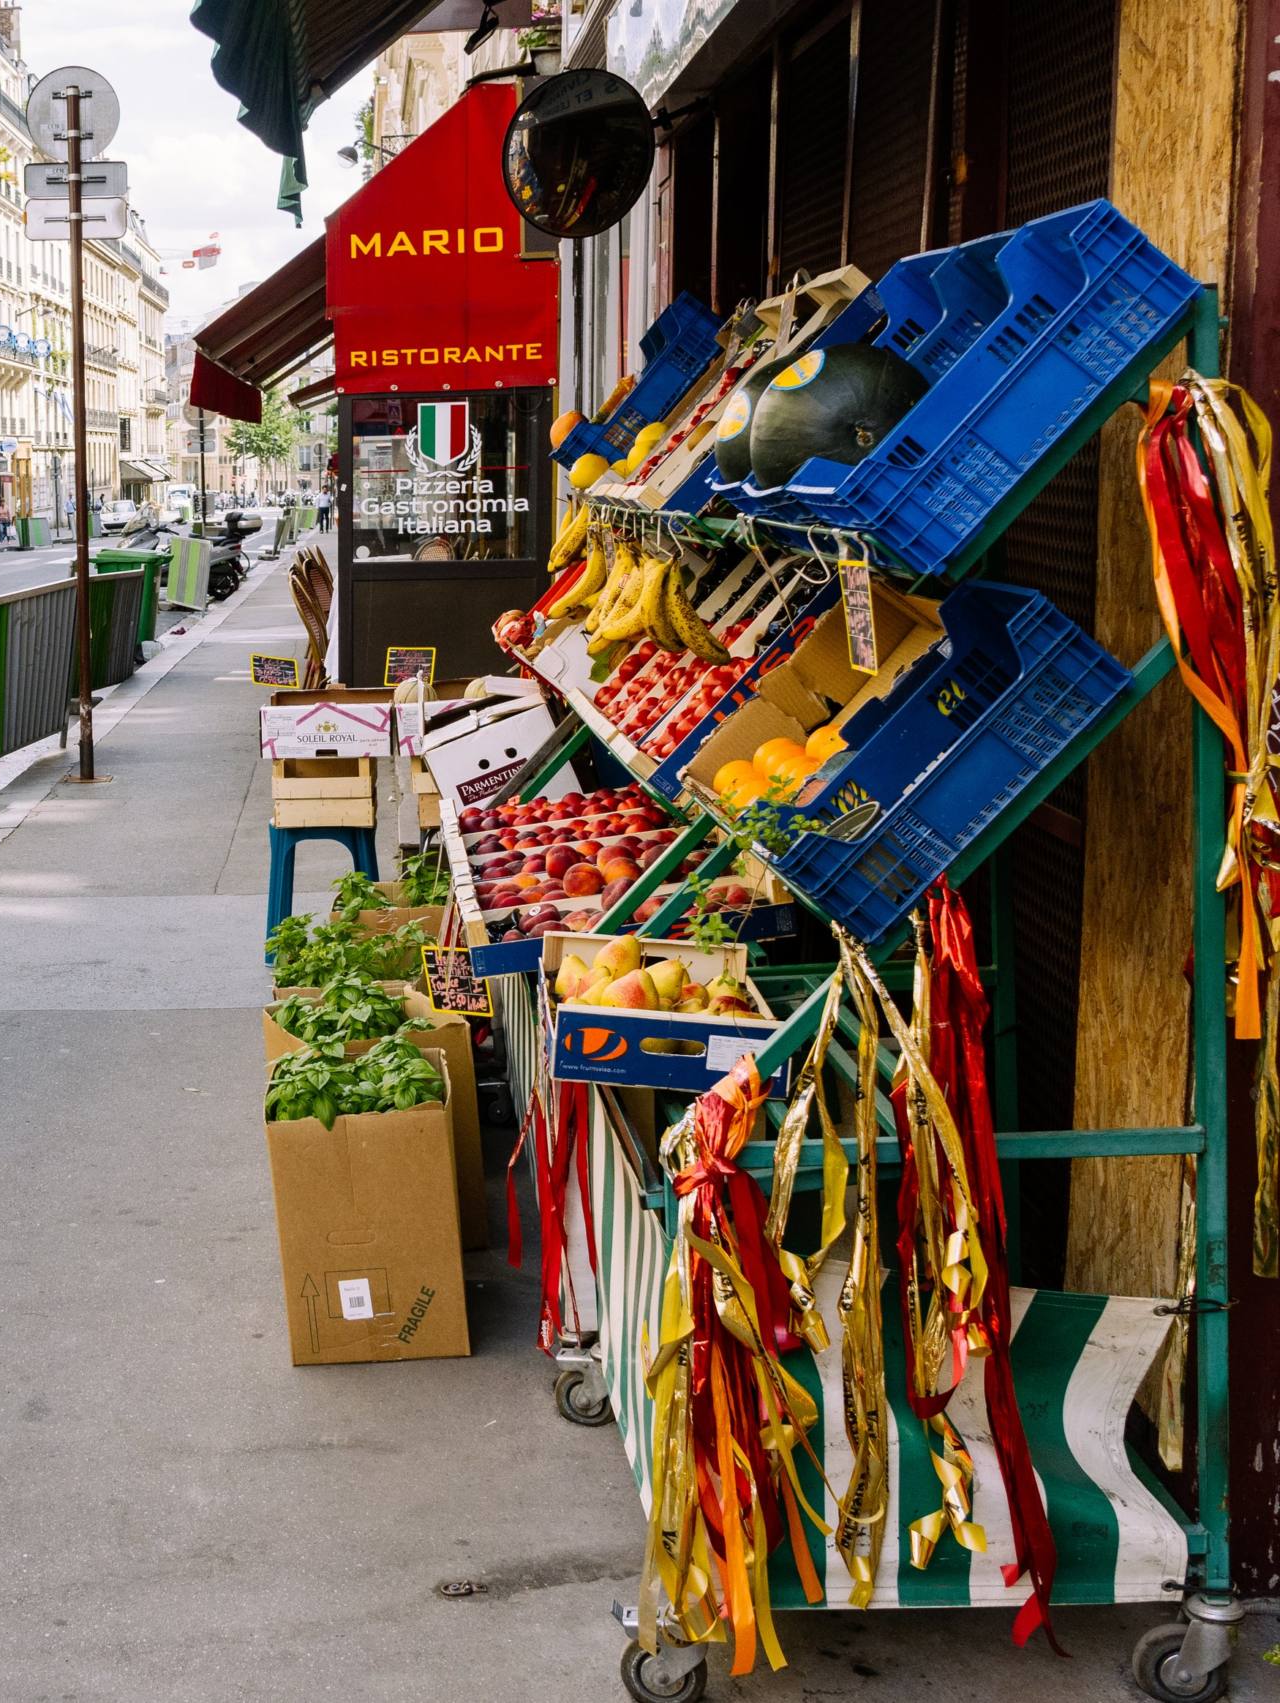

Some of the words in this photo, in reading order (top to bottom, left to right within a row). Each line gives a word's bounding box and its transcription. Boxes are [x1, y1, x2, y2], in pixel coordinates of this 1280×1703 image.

[350, 226, 504, 259] MARIO
[350, 342, 542, 367] RISTORANTE
[395, 476, 494, 496] Pizzeria
[360, 494, 530, 515] Gastronomia
[397, 516, 492, 535] Italiana
[296, 732, 327, 743] SOLEIL
[329, 733, 358, 743] ROYAL
[397, 1285, 437, 1345] FRAGILE
